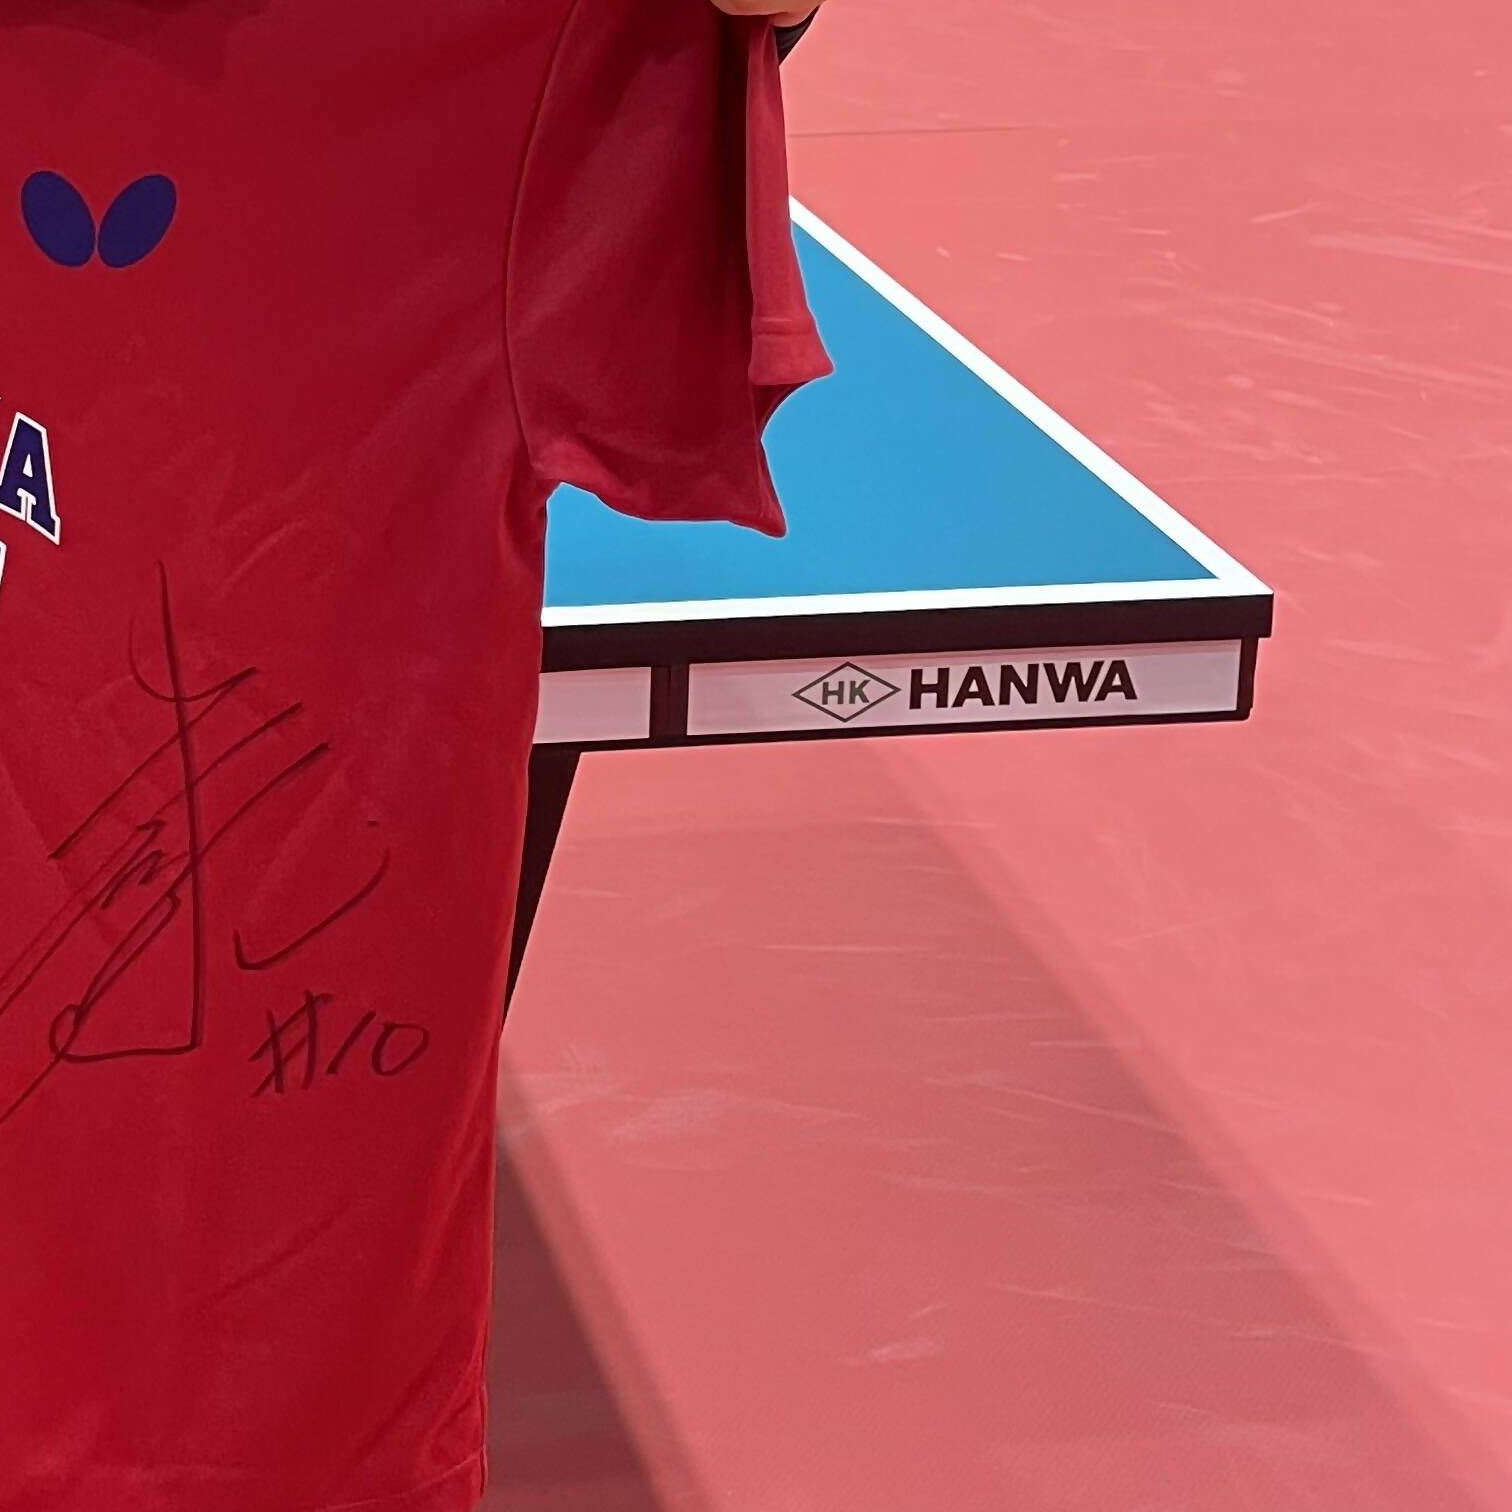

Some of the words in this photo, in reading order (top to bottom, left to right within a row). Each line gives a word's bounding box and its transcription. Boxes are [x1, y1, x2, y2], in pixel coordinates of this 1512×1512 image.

[822, 679, 871, 706] HK
[909, 659, 1138, 710] HANWA
[248, 990, 430, 1098] #10
